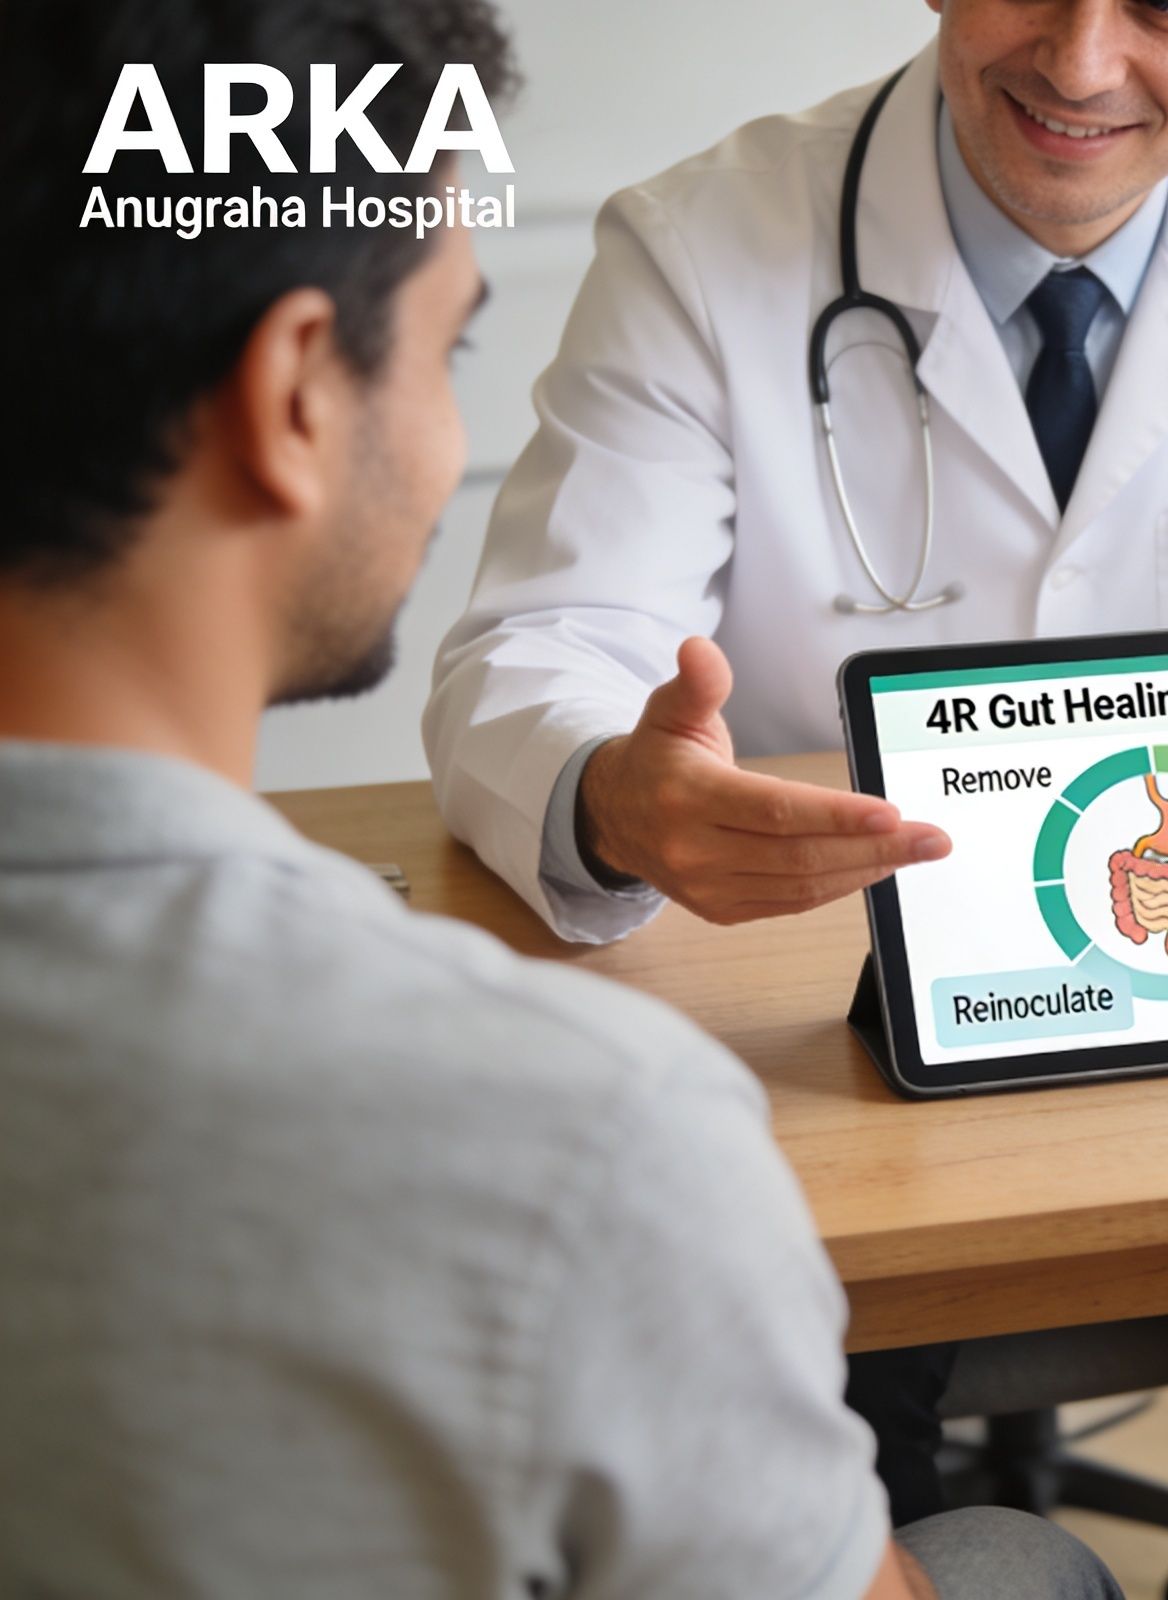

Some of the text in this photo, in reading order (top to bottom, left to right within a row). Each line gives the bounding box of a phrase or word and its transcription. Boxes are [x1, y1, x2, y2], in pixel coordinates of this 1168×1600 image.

[926, 697, 979, 734] 4R
[988, 692, 1056, 729] Gut
[942, 766, 1052, 796] Remove
[953, 983, 1113, 1025] Reinoculate
